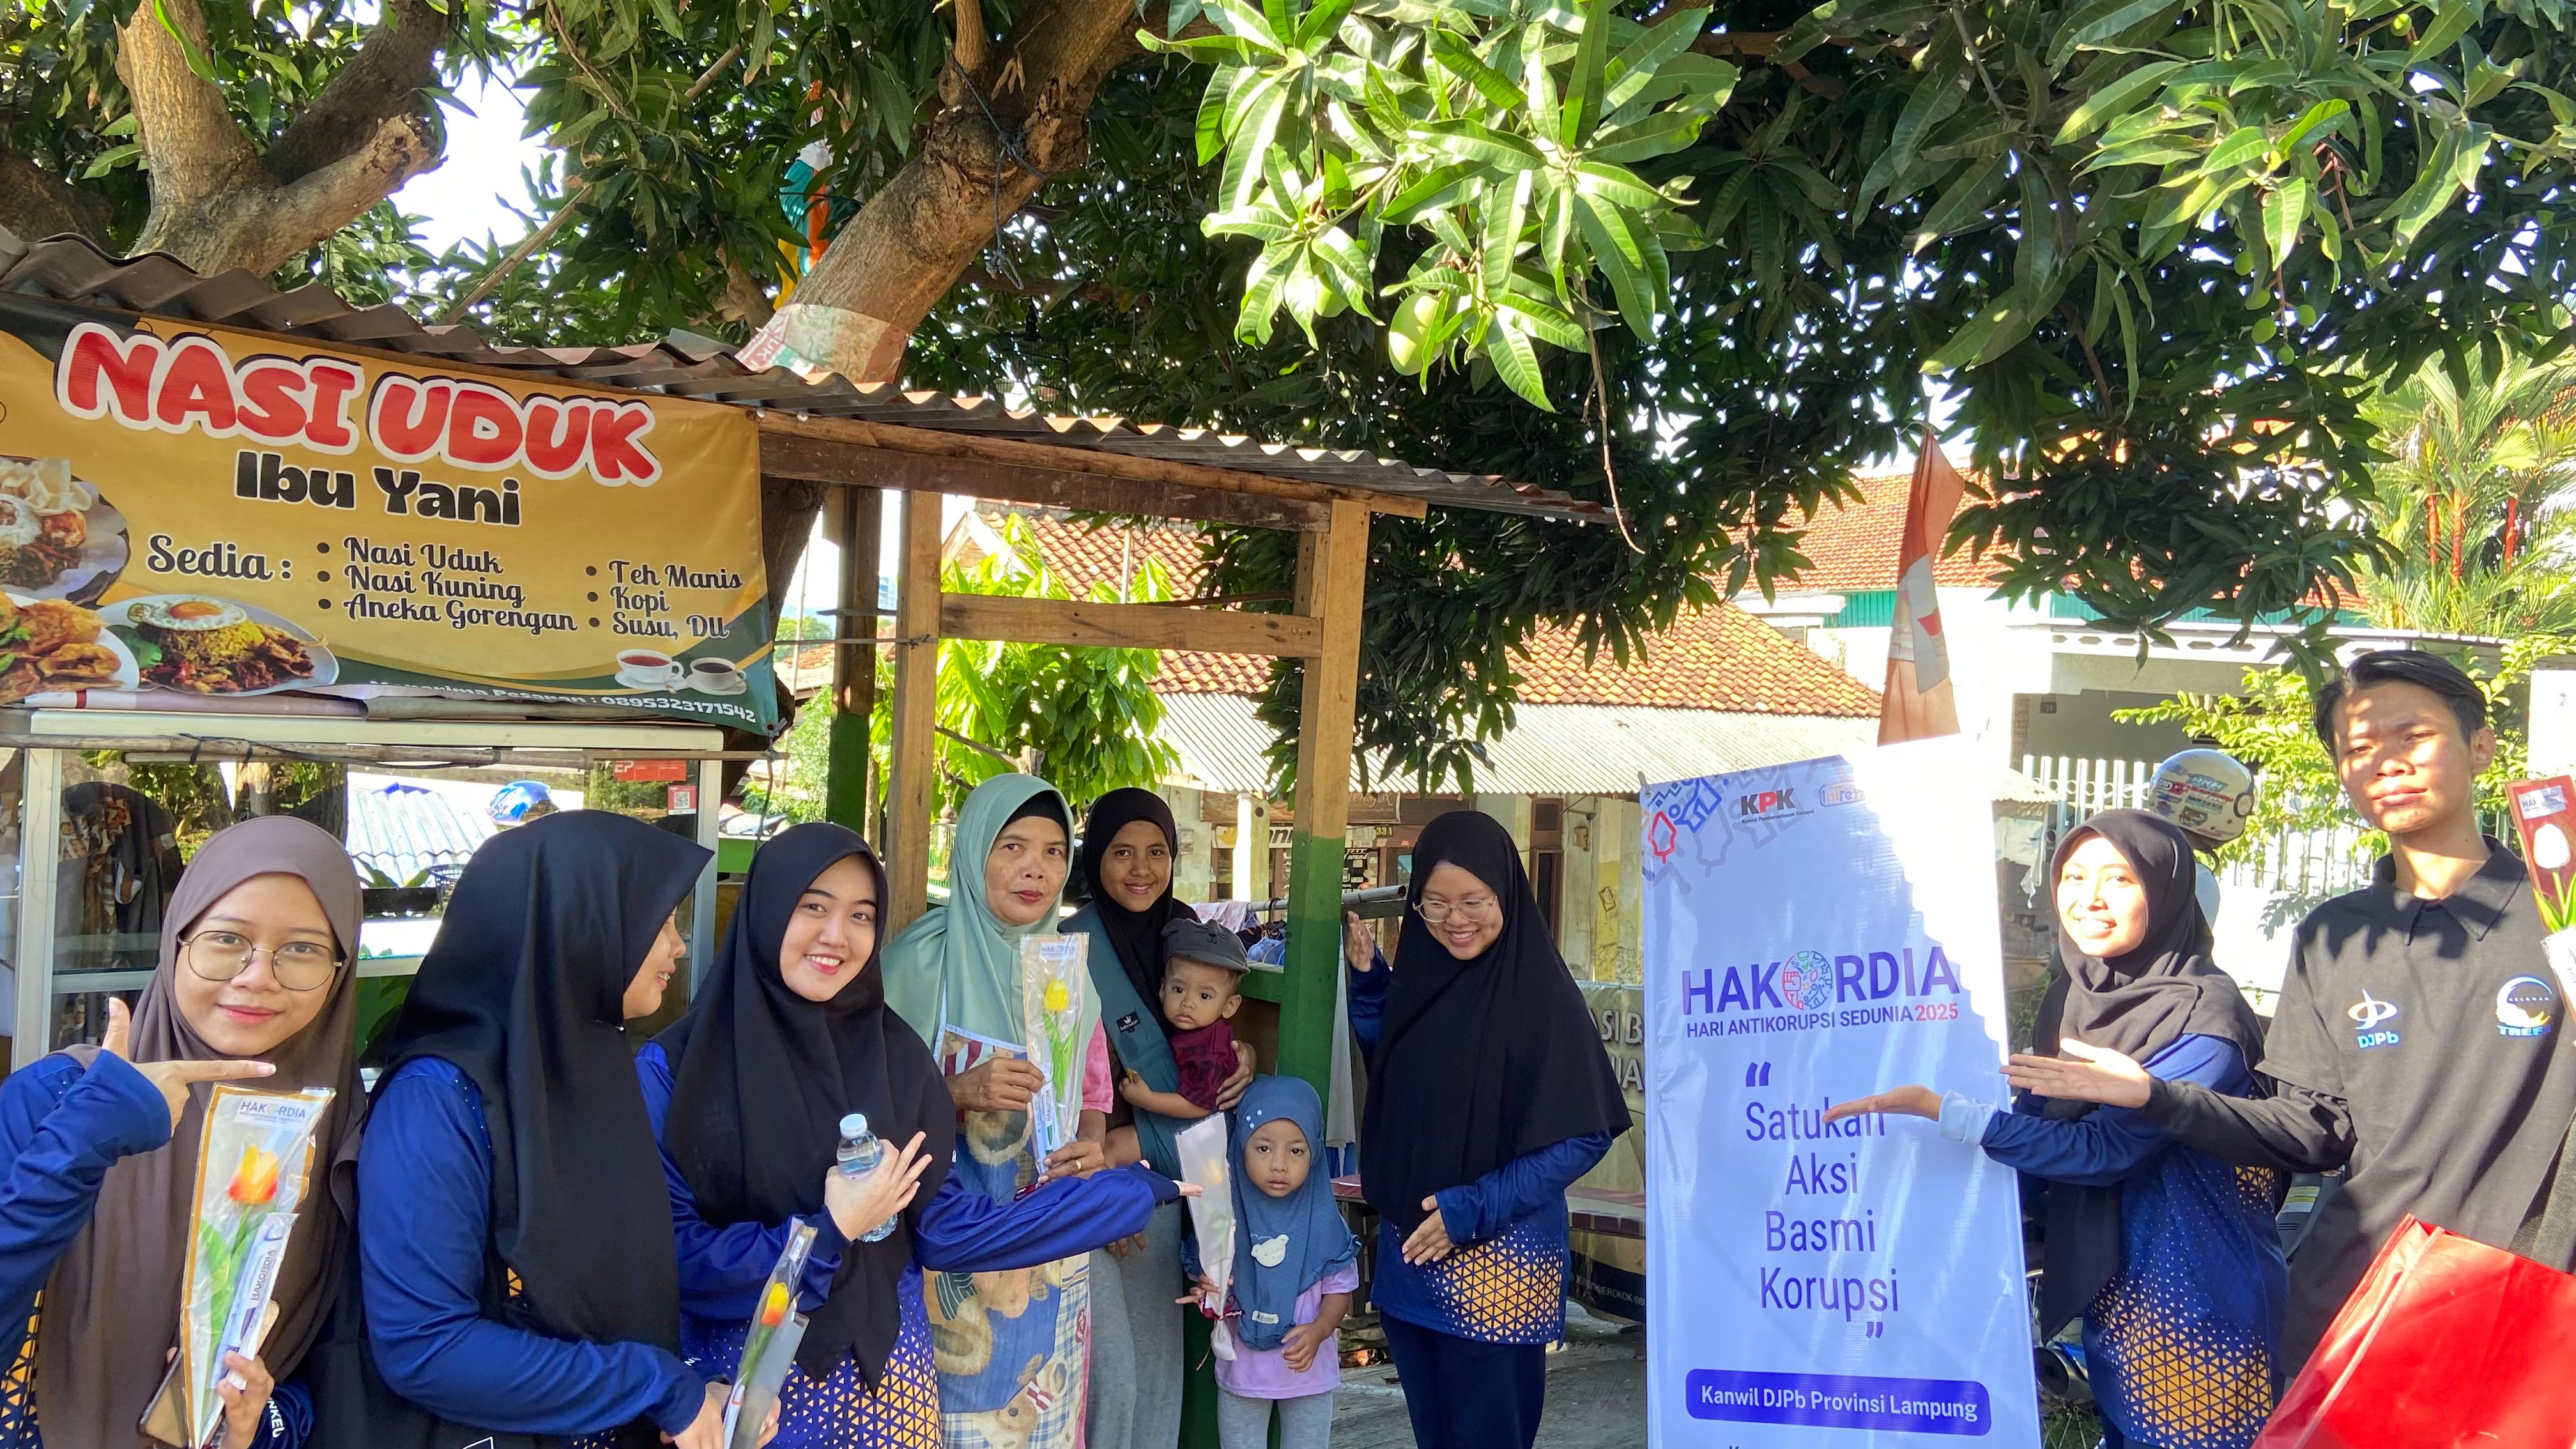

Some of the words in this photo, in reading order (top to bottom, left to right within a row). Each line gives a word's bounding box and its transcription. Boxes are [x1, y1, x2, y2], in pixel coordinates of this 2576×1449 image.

[58, 323, 364, 454] NASI
[371, 376, 662, 487] UDUK
[236, 450, 356, 509] Ibu
[373, 466, 521, 526] Yani
[147, 535, 273, 580] Sedia
[344, 537, 416, 566] Nasi
[420, 544, 503, 574] Uduk
[344, 565, 417, 594] Nasi
[420, 570, 525, 608] Kuning
[609, 560, 661, 586] Teh
[664, 565, 744, 589] Manis
[343, 593, 441, 622] Aneka
[447, 599, 578, 634] Gorengan
[610, 586, 670, 617] Kopi
[612, 612, 678, 640] Susu,
[601, 697, 756, 723] 0895323171542
[1741, 788, 1795, 816] KPK
[1687, 1020, 1724, 1038] HARI
[1728, 1011, 1835, 1035] ANTIKORUPSI
[1840, 1005, 1913, 1027] SEDUNIA
[1914, 1002, 1959, 1022] 2025
[2357, 1031, 2400, 1048] DJPb
[1785, 1152, 1858, 1195] Aksi
[1765, 1209, 1876, 1252] Basmi
[1760, 1268, 1899, 1322] Korupsi
[1701, 1385, 1759, 1406] Kanwil
[1763, 1388, 1805, 1409] DJPb
[1811, 1391, 1885, 1414] Provinsi
[1890, 1395, 1978, 1422] Lampung
